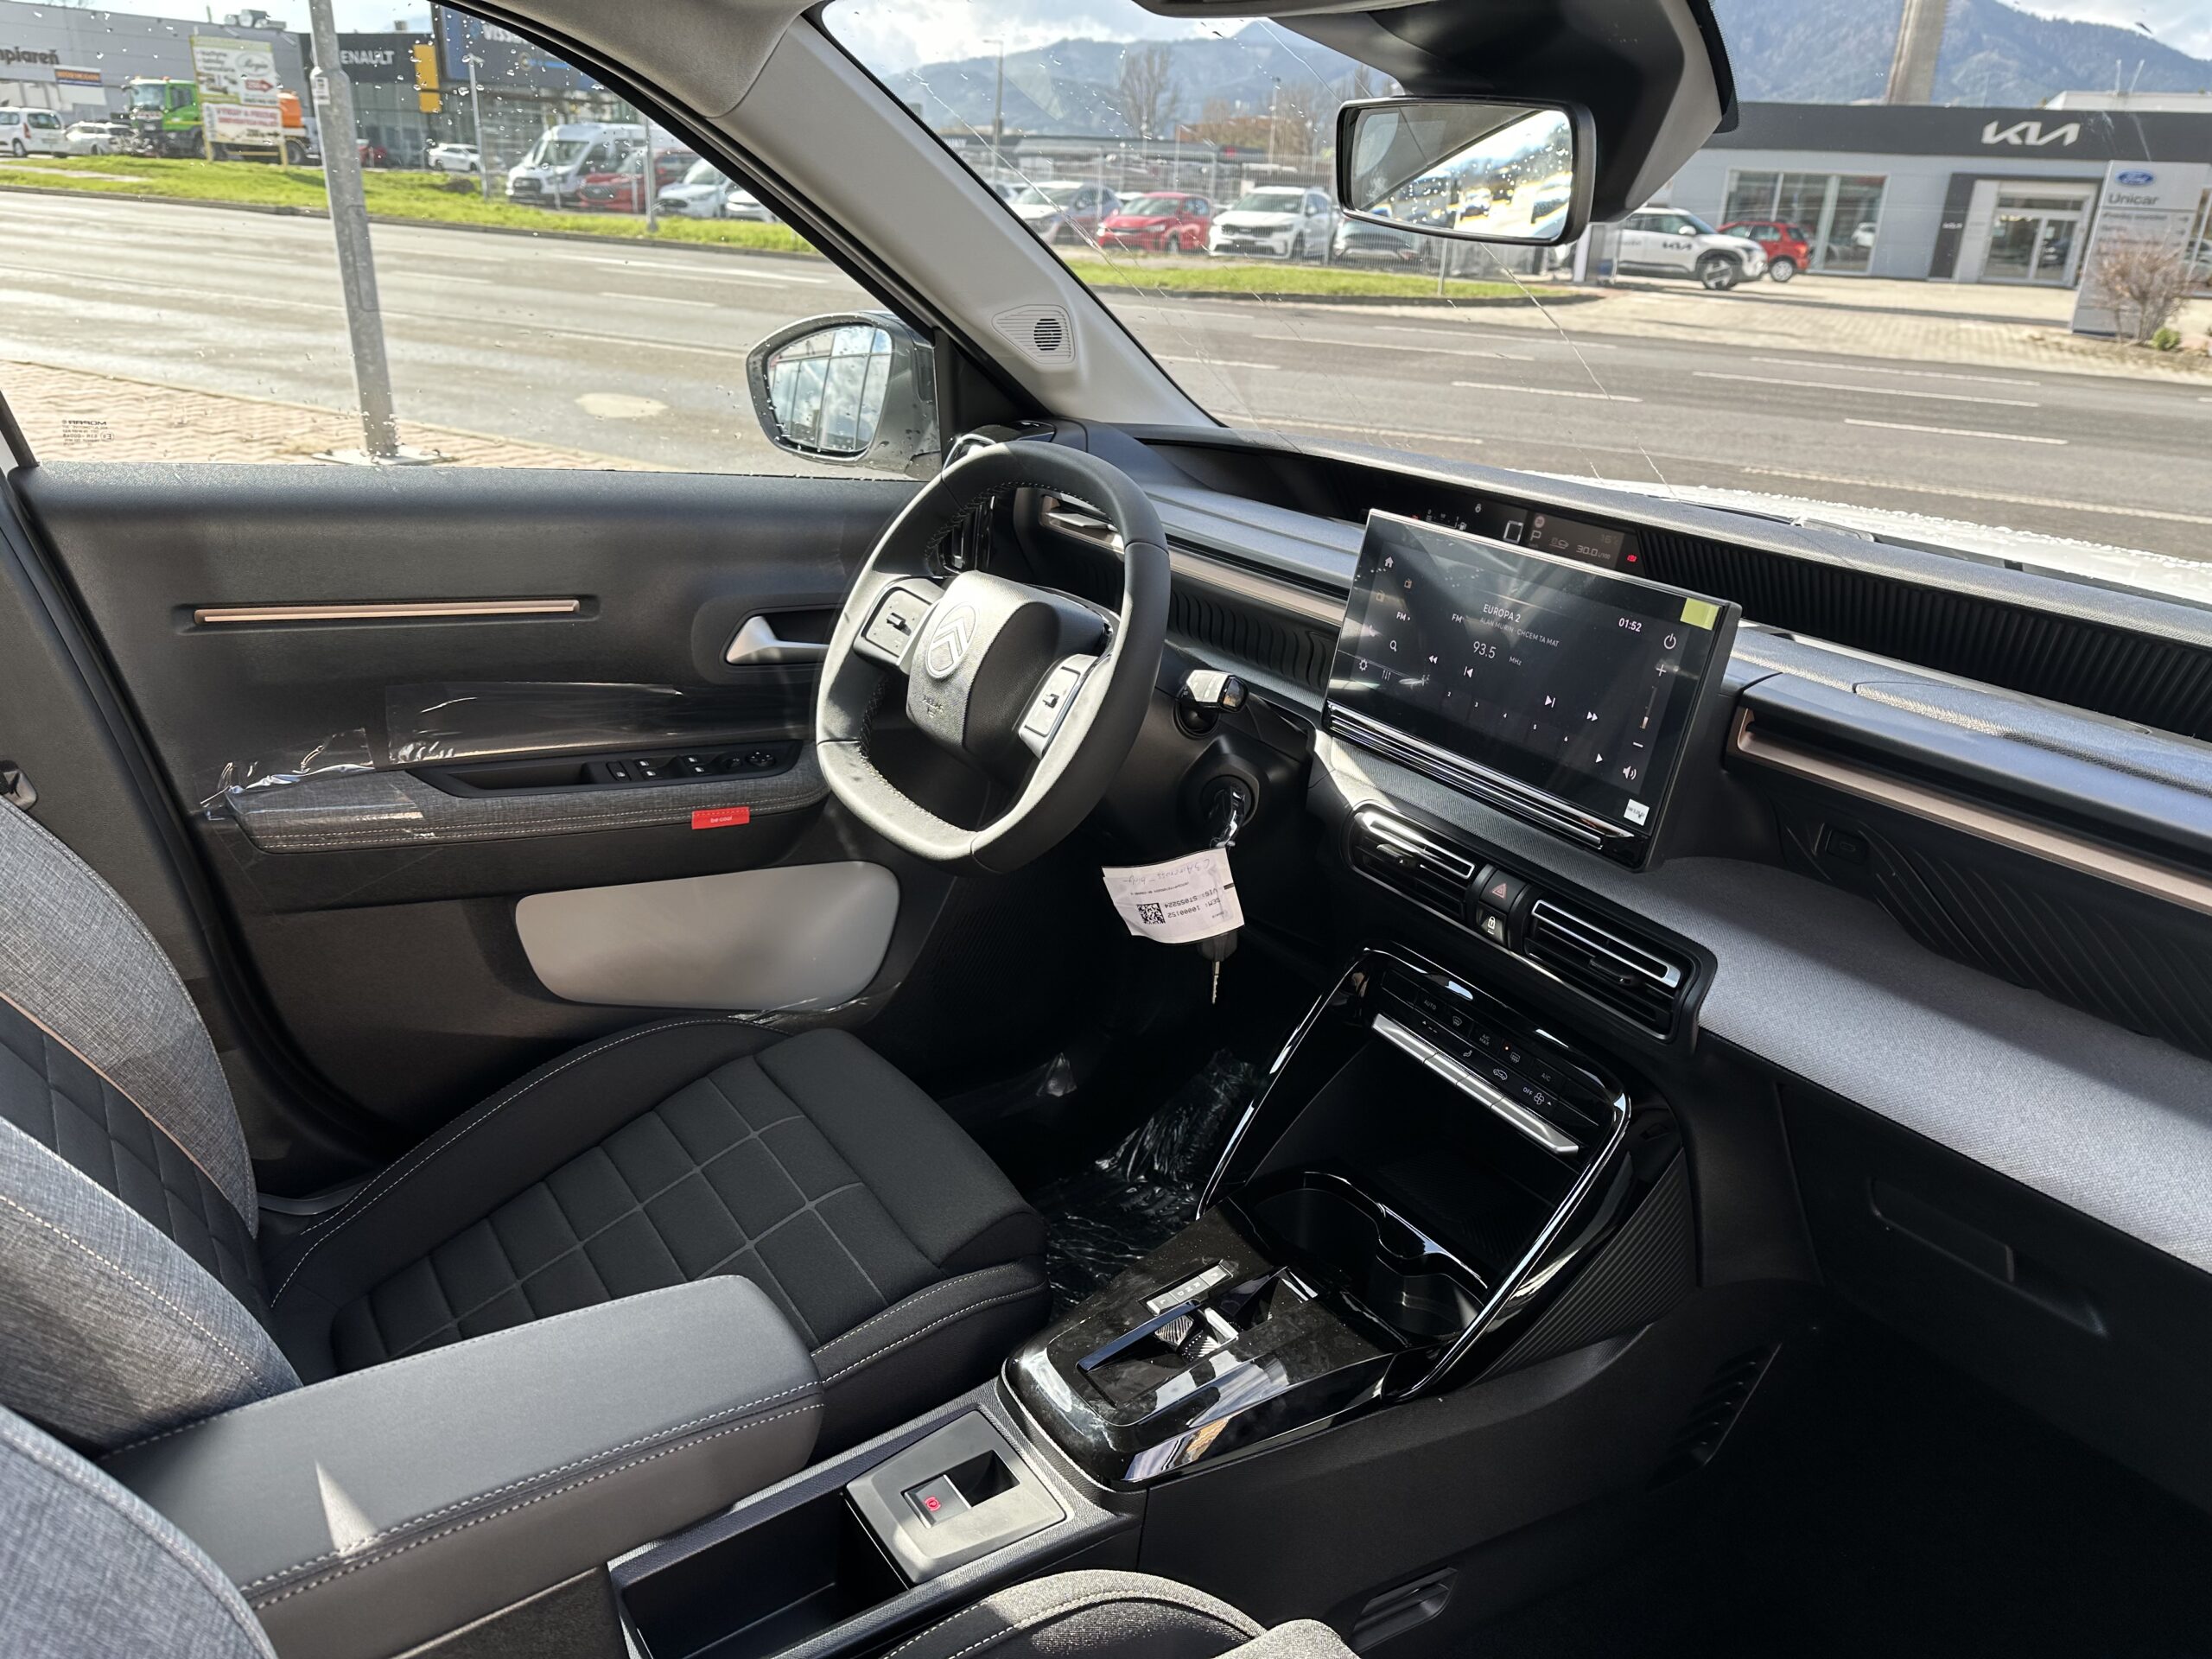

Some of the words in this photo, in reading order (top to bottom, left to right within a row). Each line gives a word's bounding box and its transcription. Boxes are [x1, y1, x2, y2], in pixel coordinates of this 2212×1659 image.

[339, 49, 395, 65] ENAULT
[1981, 120, 2081, 146] KIA
[2108, 193, 2159, 206] Unicar
[1395, 611, 1407, 622] FM
[1451, 613, 1463, 624] FM
[1483, 603, 1515, 620] EUROPA
[1515, 613, 1522, 624] 2
[1618, 617, 1642, 632] 01:52
[1516, 628, 1539, 641] CHCEM
[1547, 637, 1560, 648] MAT
[1472, 640, 1497, 659] 93.5
[1423, 999, 1437, 1011] AUTO
[1522, 1086, 1533, 1096] OFF
